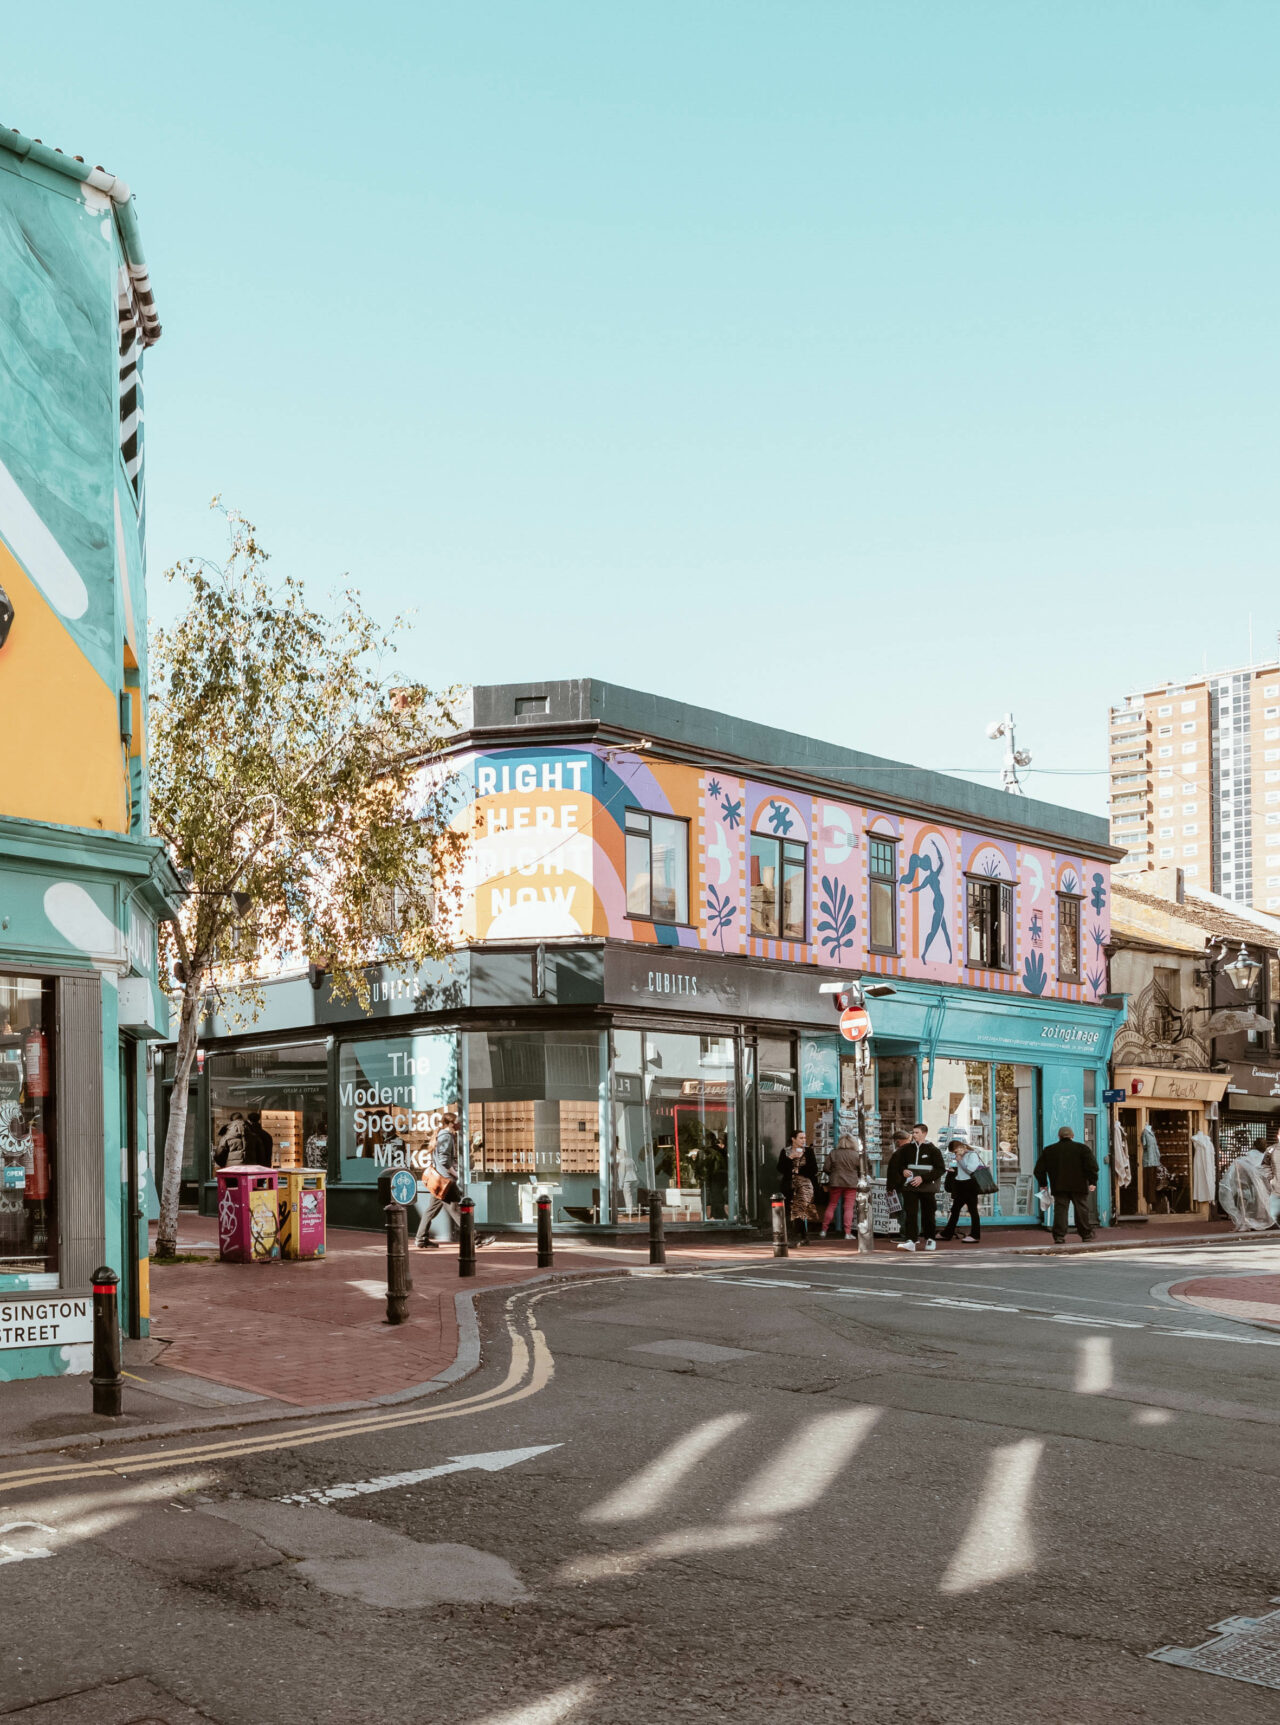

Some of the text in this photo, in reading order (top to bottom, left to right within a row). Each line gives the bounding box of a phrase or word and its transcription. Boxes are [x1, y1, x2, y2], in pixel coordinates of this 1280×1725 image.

[478, 761, 587, 796] RIGHT
[487, 805, 579, 834] HERE
[491, 886, 577, 917] NOW
[648, 971, 697, 996] CUBITTS
[1041, 1025, 1099, 1044] zoingimage
[388, 1052, 430, 1076] The
[340, 1082, 416, 1106] Modern
[374, 1142, 436, 1168] Make
[512, 1151, 561, 1164] CUBITTS
